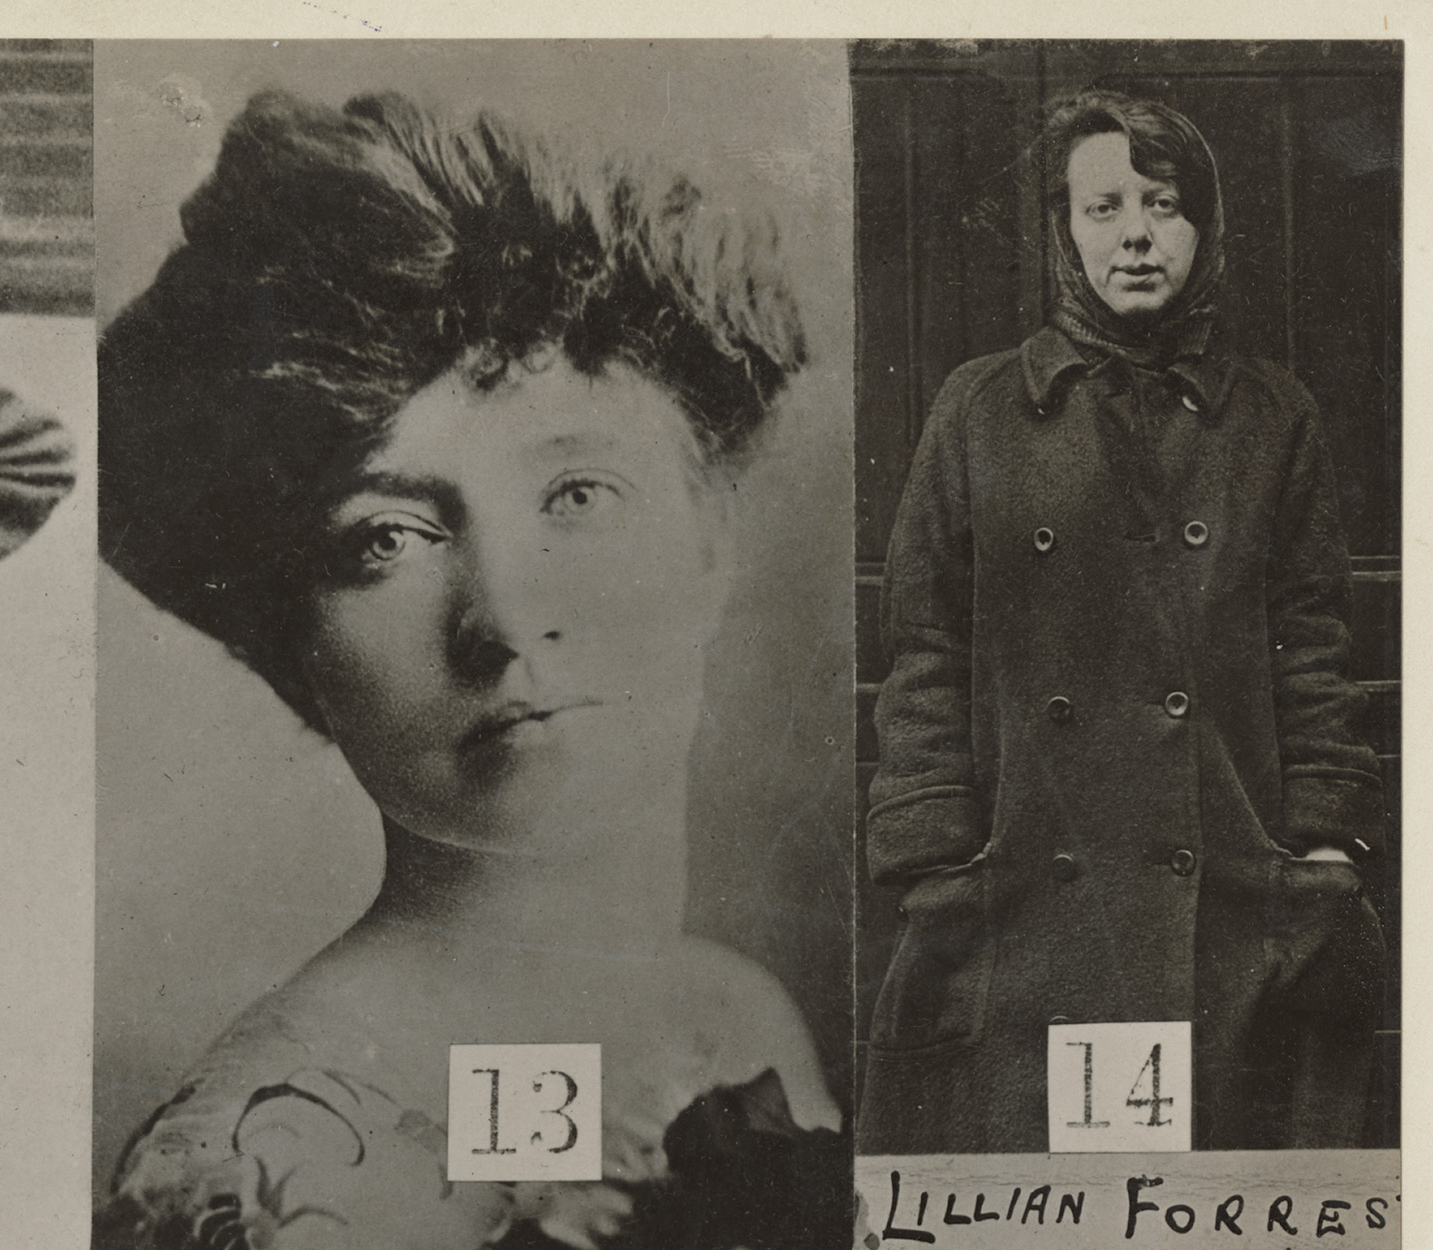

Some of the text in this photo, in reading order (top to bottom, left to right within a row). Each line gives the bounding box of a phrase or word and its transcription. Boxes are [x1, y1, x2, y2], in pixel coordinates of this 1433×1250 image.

[472, 1069, 578, 1154] 13
[1067, 1042, 1173, 1128] 14
[882, 1170, 1401, 1244] LILLIAN FORRES
